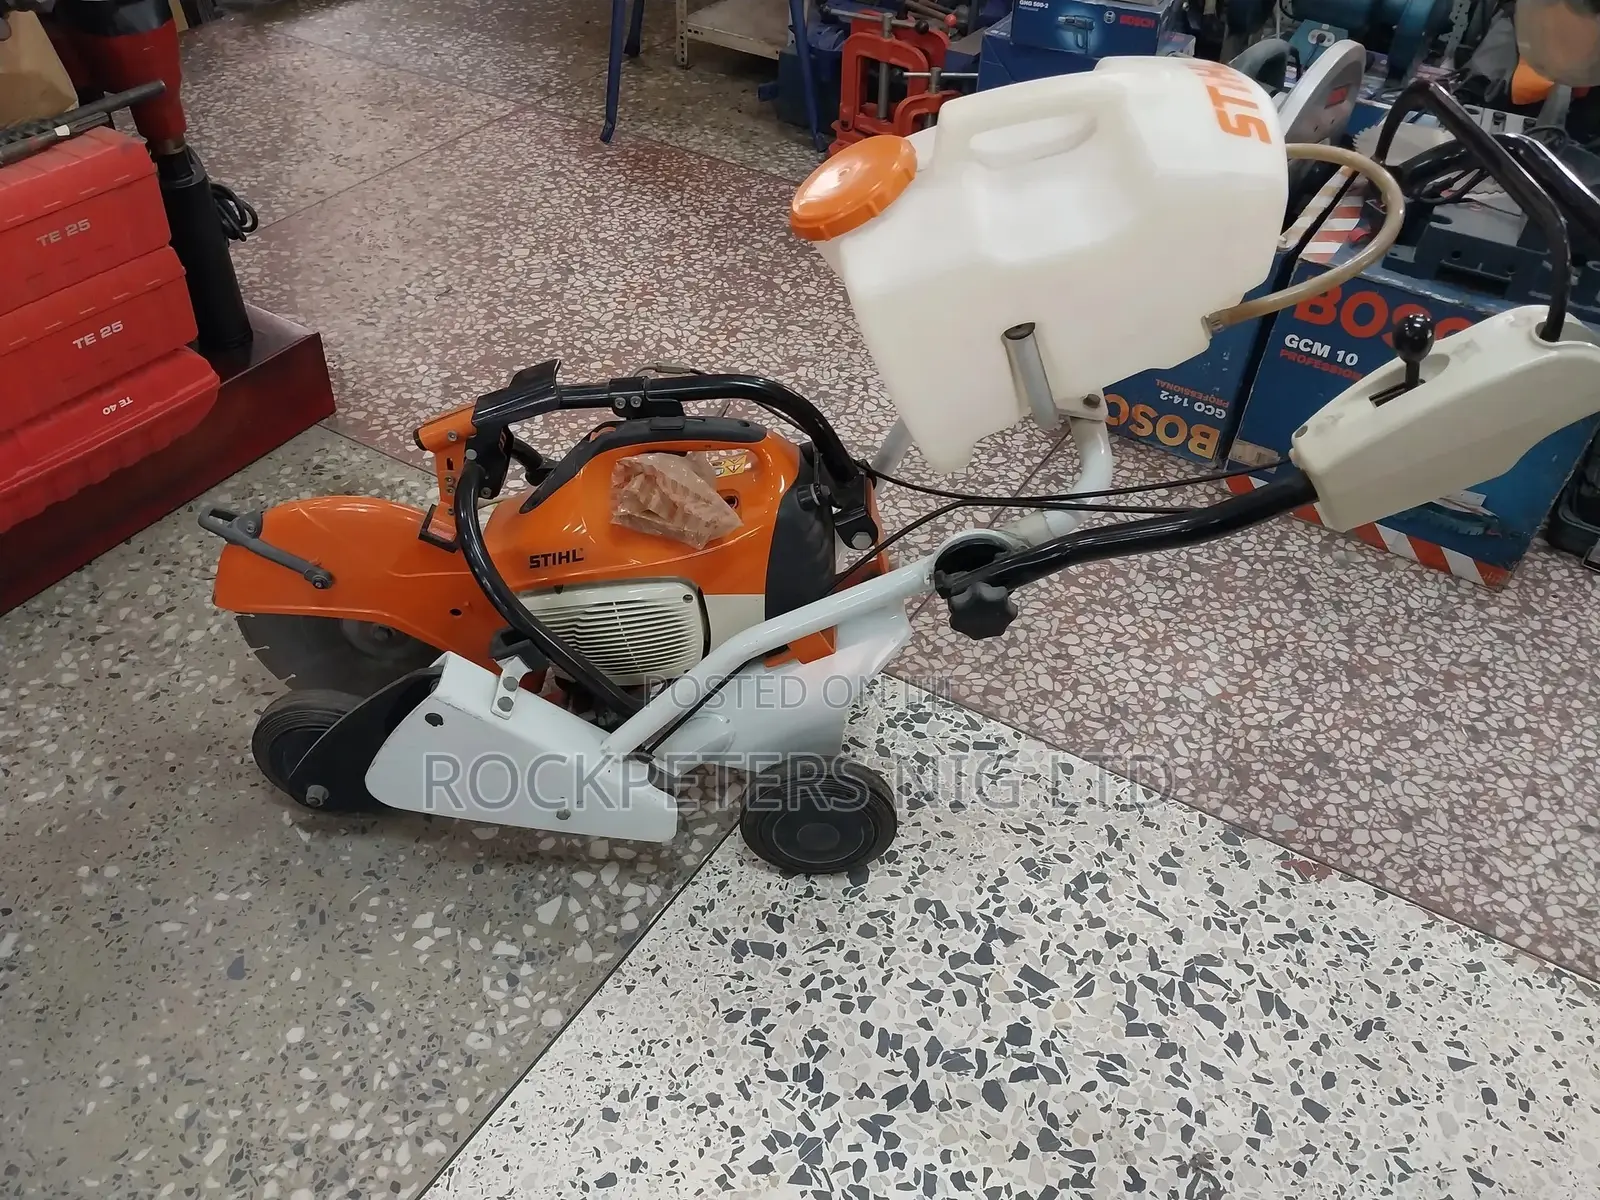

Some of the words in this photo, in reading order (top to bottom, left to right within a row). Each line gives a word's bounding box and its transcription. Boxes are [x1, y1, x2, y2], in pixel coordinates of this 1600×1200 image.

[36, 230, 62, 247] TE
[65, 218, 92, 237] 25
[72, 332, 97, 350] TE
[100, 320, 124, 339] 25
[1284, 333, 1331, 359] GCM
[1336, 349, 1359, 367] 10
[1280, 348, 1365, 382] PROFESSION
[118, 395, 134, 408] TE
[1155, 378, 1230, 408] PROFESSIONAL
[1160, 390, 1189, 407] 14-2
[102, 403, 117, 415] 40
[1193, 401, 1227, 419] GCO
[1104, 393, 1220, 459] BOSC
[529, 548, 584, 569] STIHL
